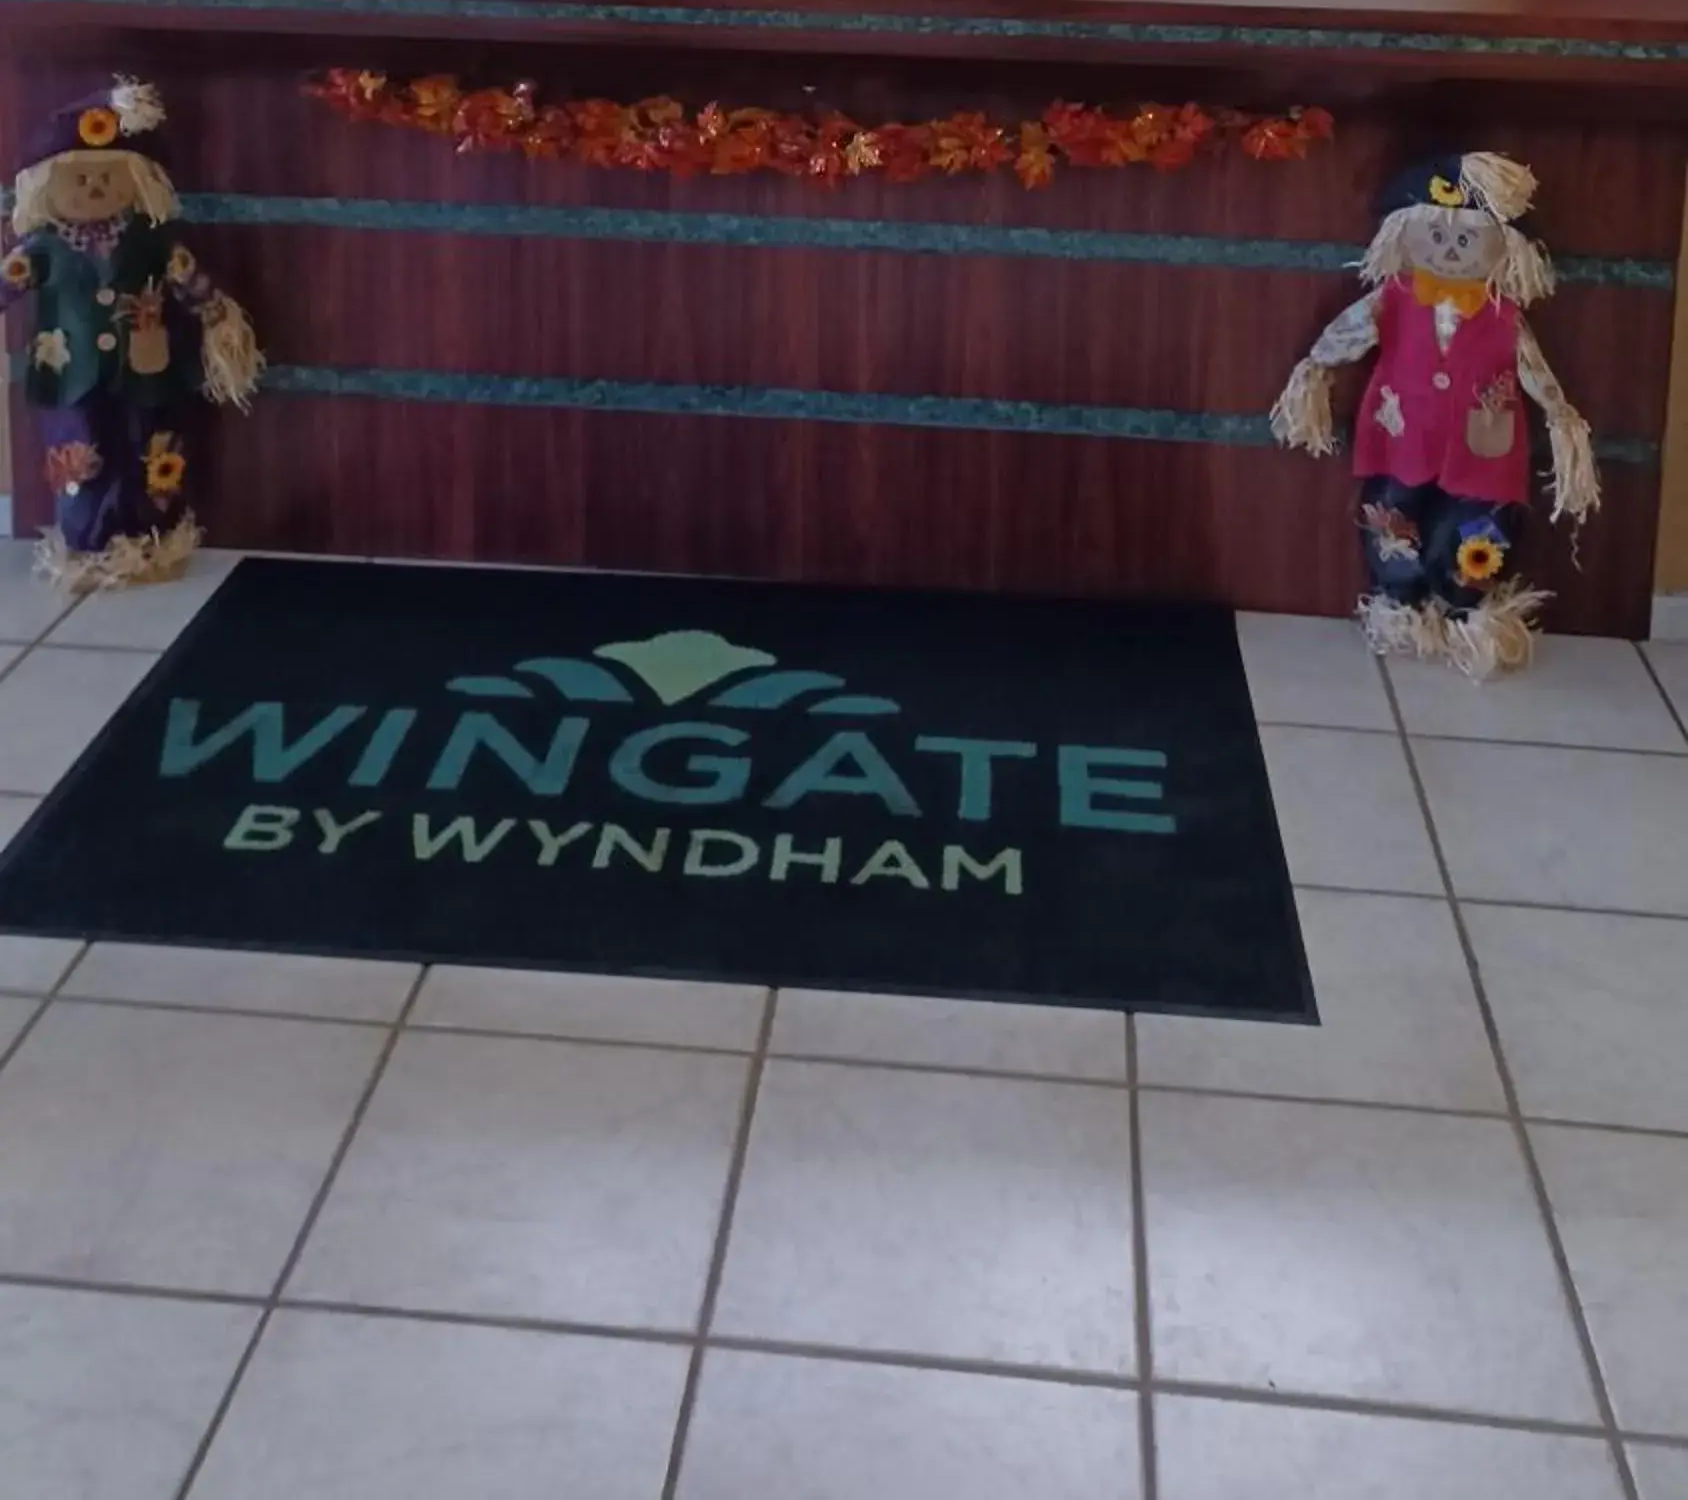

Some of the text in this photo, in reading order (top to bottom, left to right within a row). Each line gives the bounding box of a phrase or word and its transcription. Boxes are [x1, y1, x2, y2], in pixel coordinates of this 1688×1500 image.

[159, 698, 1178, 834] WINGATE
[223, 805, 1023, 895] BY WYNDHAM
